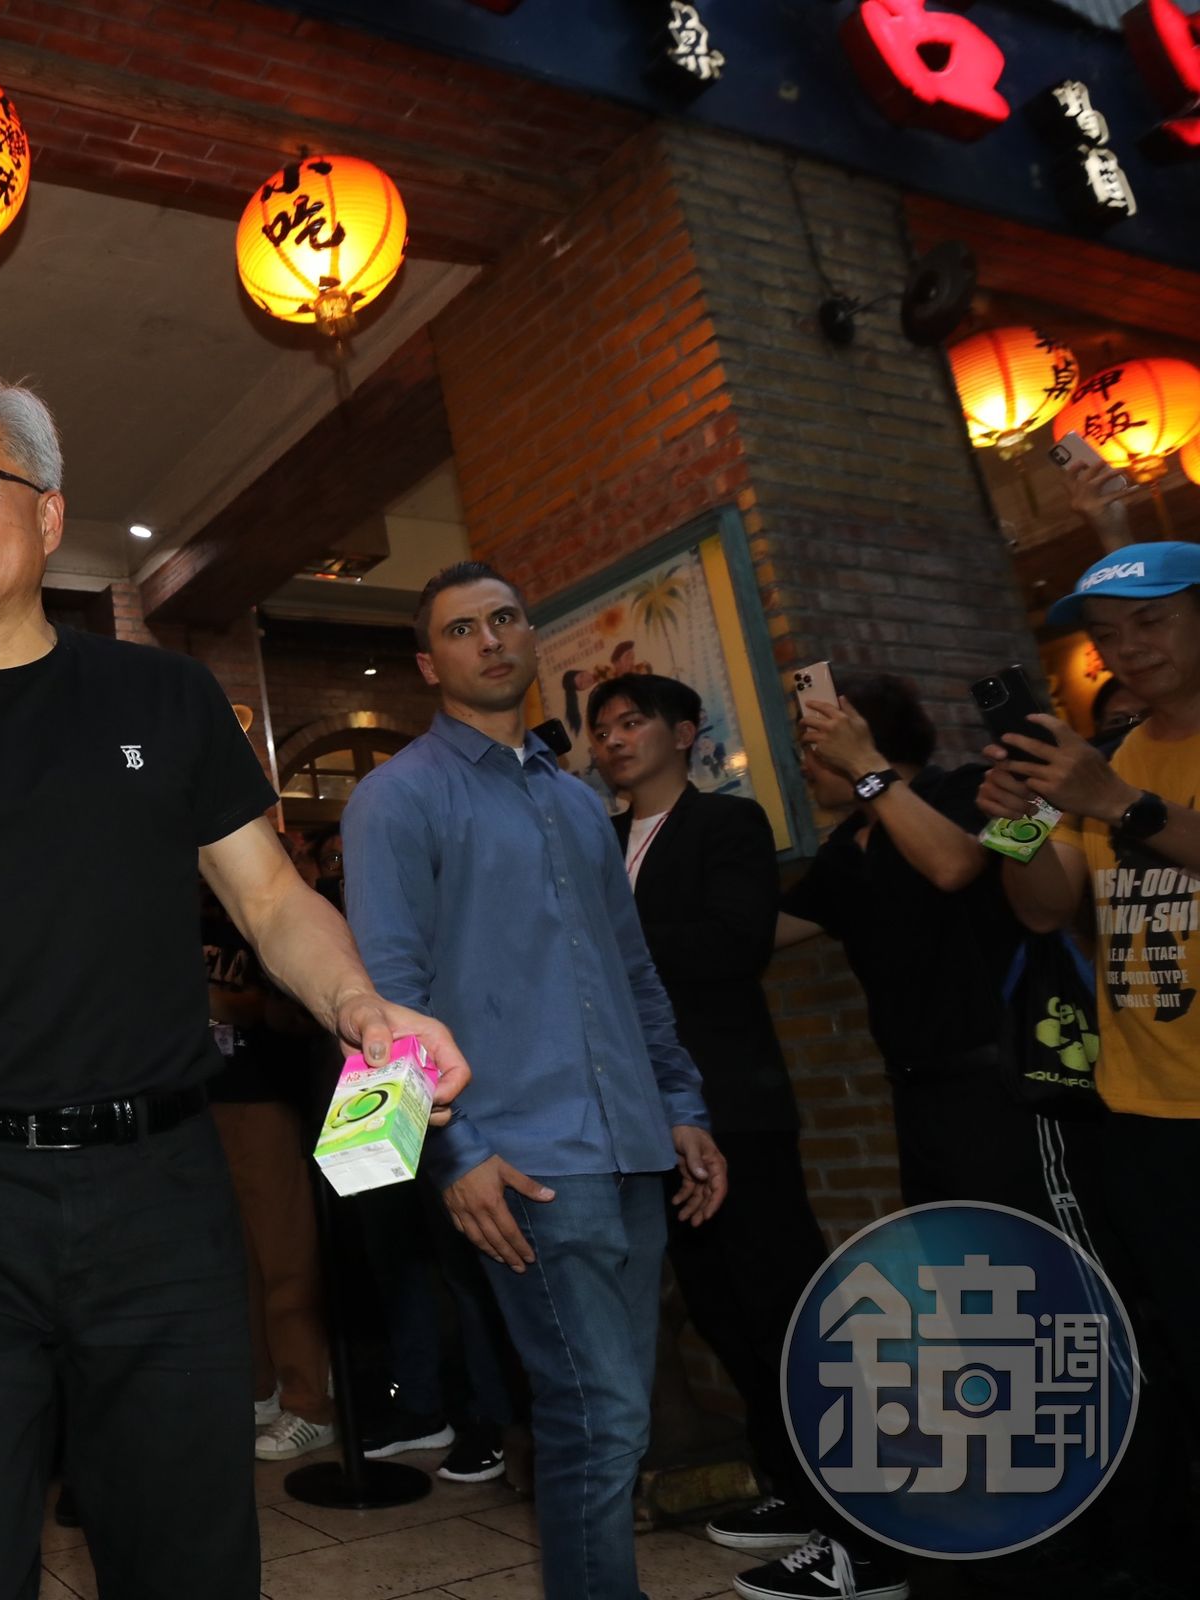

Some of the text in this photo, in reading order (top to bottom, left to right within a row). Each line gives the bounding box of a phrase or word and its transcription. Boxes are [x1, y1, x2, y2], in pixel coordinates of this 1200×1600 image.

[261, 157, 346, 251] 小吃
[1141, 946, 1186, 961] ATTACK
[1121, 969, 1189, 985] PROTOTYPE
[1153, 993, 1181, 1008] SUIT
